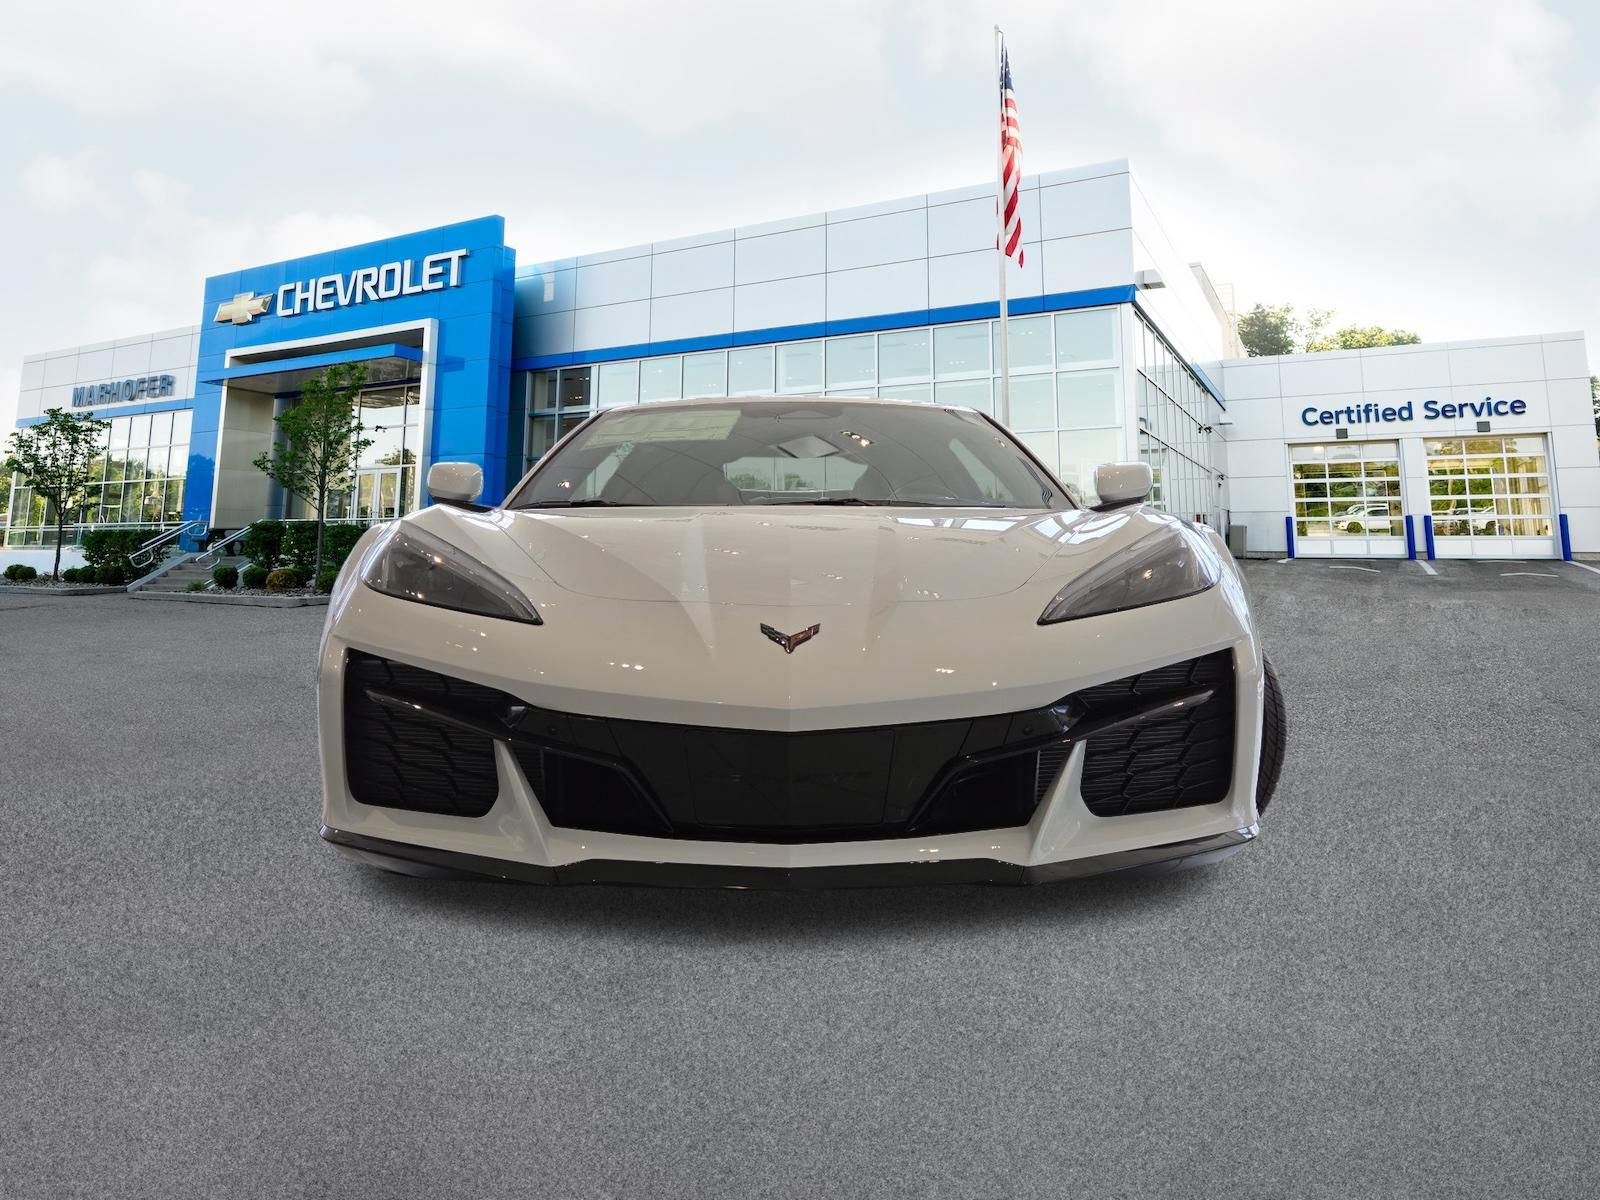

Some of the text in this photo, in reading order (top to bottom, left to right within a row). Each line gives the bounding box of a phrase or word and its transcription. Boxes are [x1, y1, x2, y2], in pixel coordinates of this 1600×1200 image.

[276, 248, 468, 317] CHEVROLET
[72, 375, 175, 407] MARHOFER
[1301, 397, 1527, 426] Certified Service
